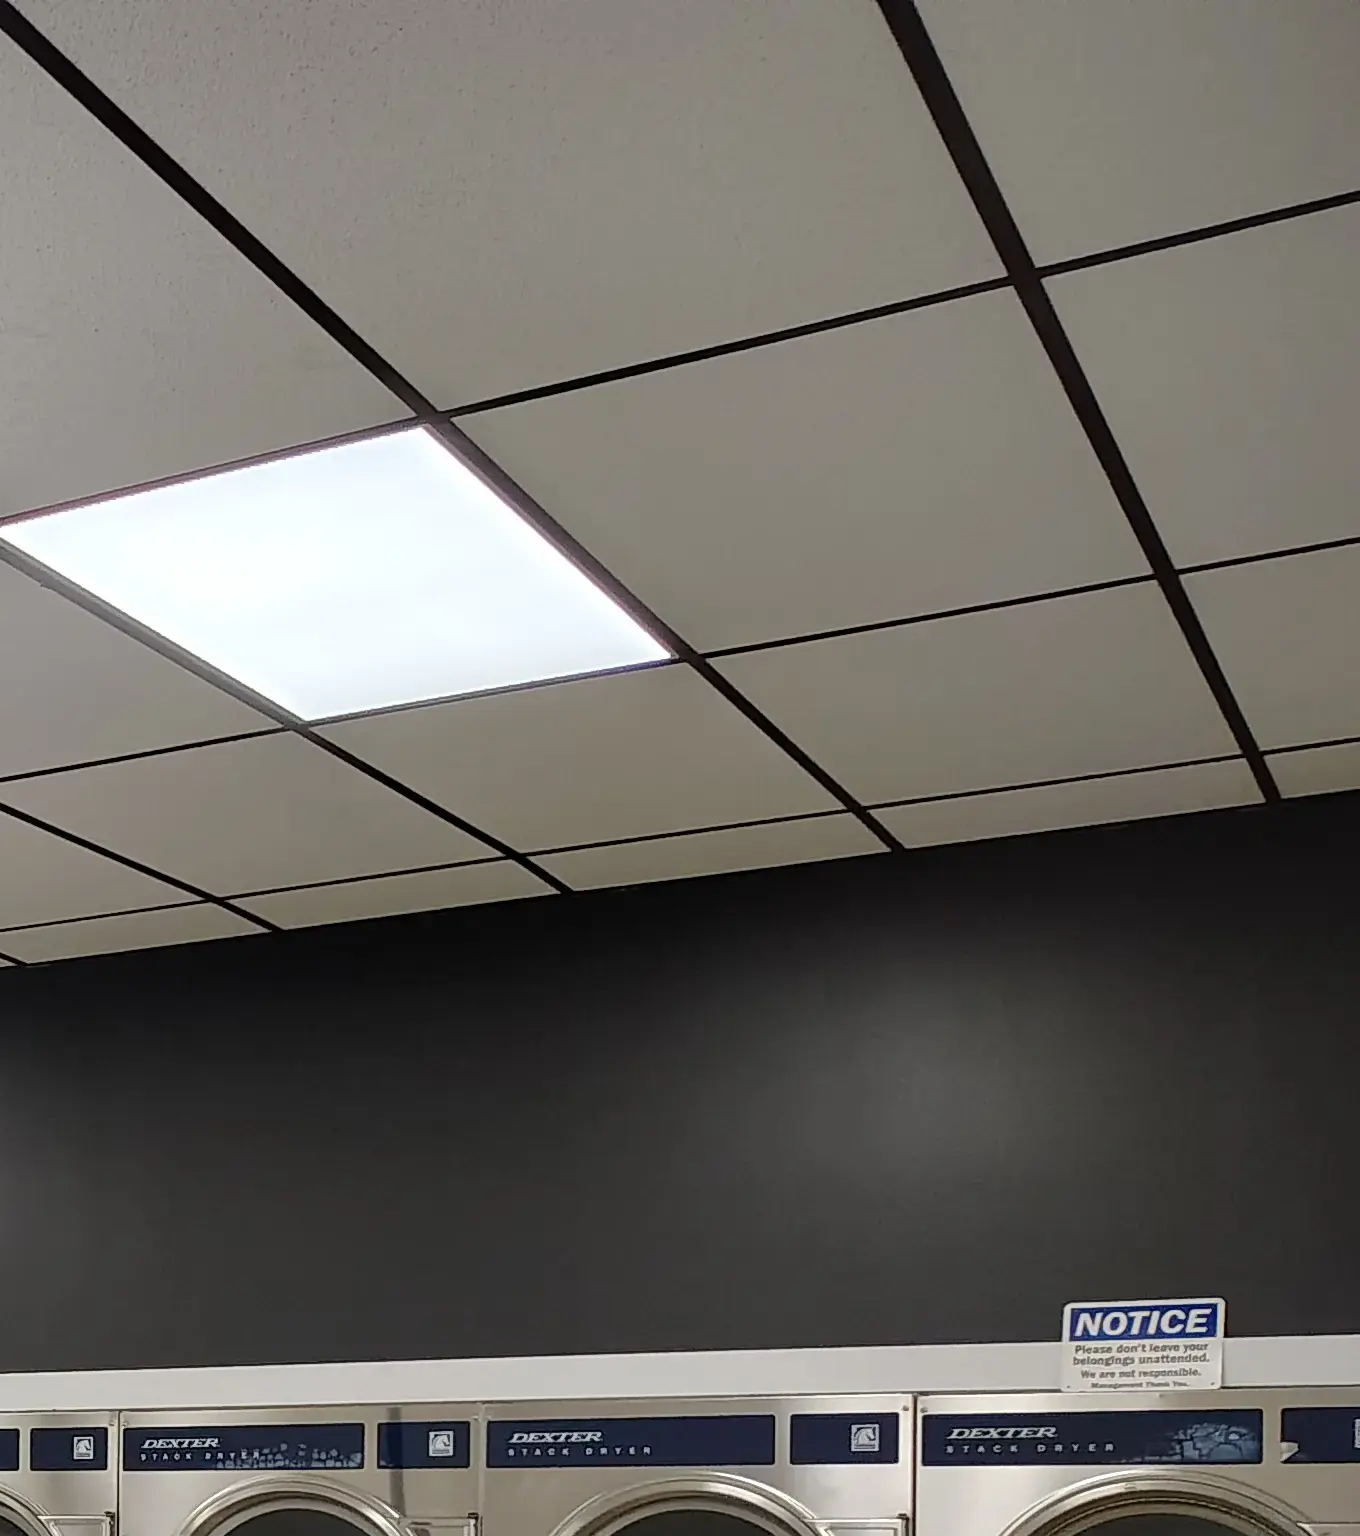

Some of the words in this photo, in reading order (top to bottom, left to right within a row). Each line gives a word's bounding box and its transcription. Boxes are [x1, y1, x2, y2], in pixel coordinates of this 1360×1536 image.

[1074, 1308, 1212, 1337] NOTICE
[1075, 1344, 1112, 1355] Please
[1116, 1343, 1147, 1354] don't
[1149, 1343, 1180, 1353] leave
[1183, 1343, 1208, 1353] your
[1073, 1355, 1135, 1367] belongings
[1139, 1353, 1210, 1365] unattended.
[1081, 1370, 1096, 1379] We
[1099, 1370, 1116, 1378] are
[1119, 1369, 1136, 1378] not
[1138, 1368, 1202, 1379] responsible.
[508, 1431, 604, 1444] DEXTER
[946, 1426, 1058, 1440] DEXTER
[141, 1438, 220, 1449] DEXTER
[946, 1444, 1019, 1454] STACK
[1037, 1443, 1114, 1453] DRYER
[508, 1448, 570, 1457] STACK
[585, 1447, 651, 1456] DRYER
